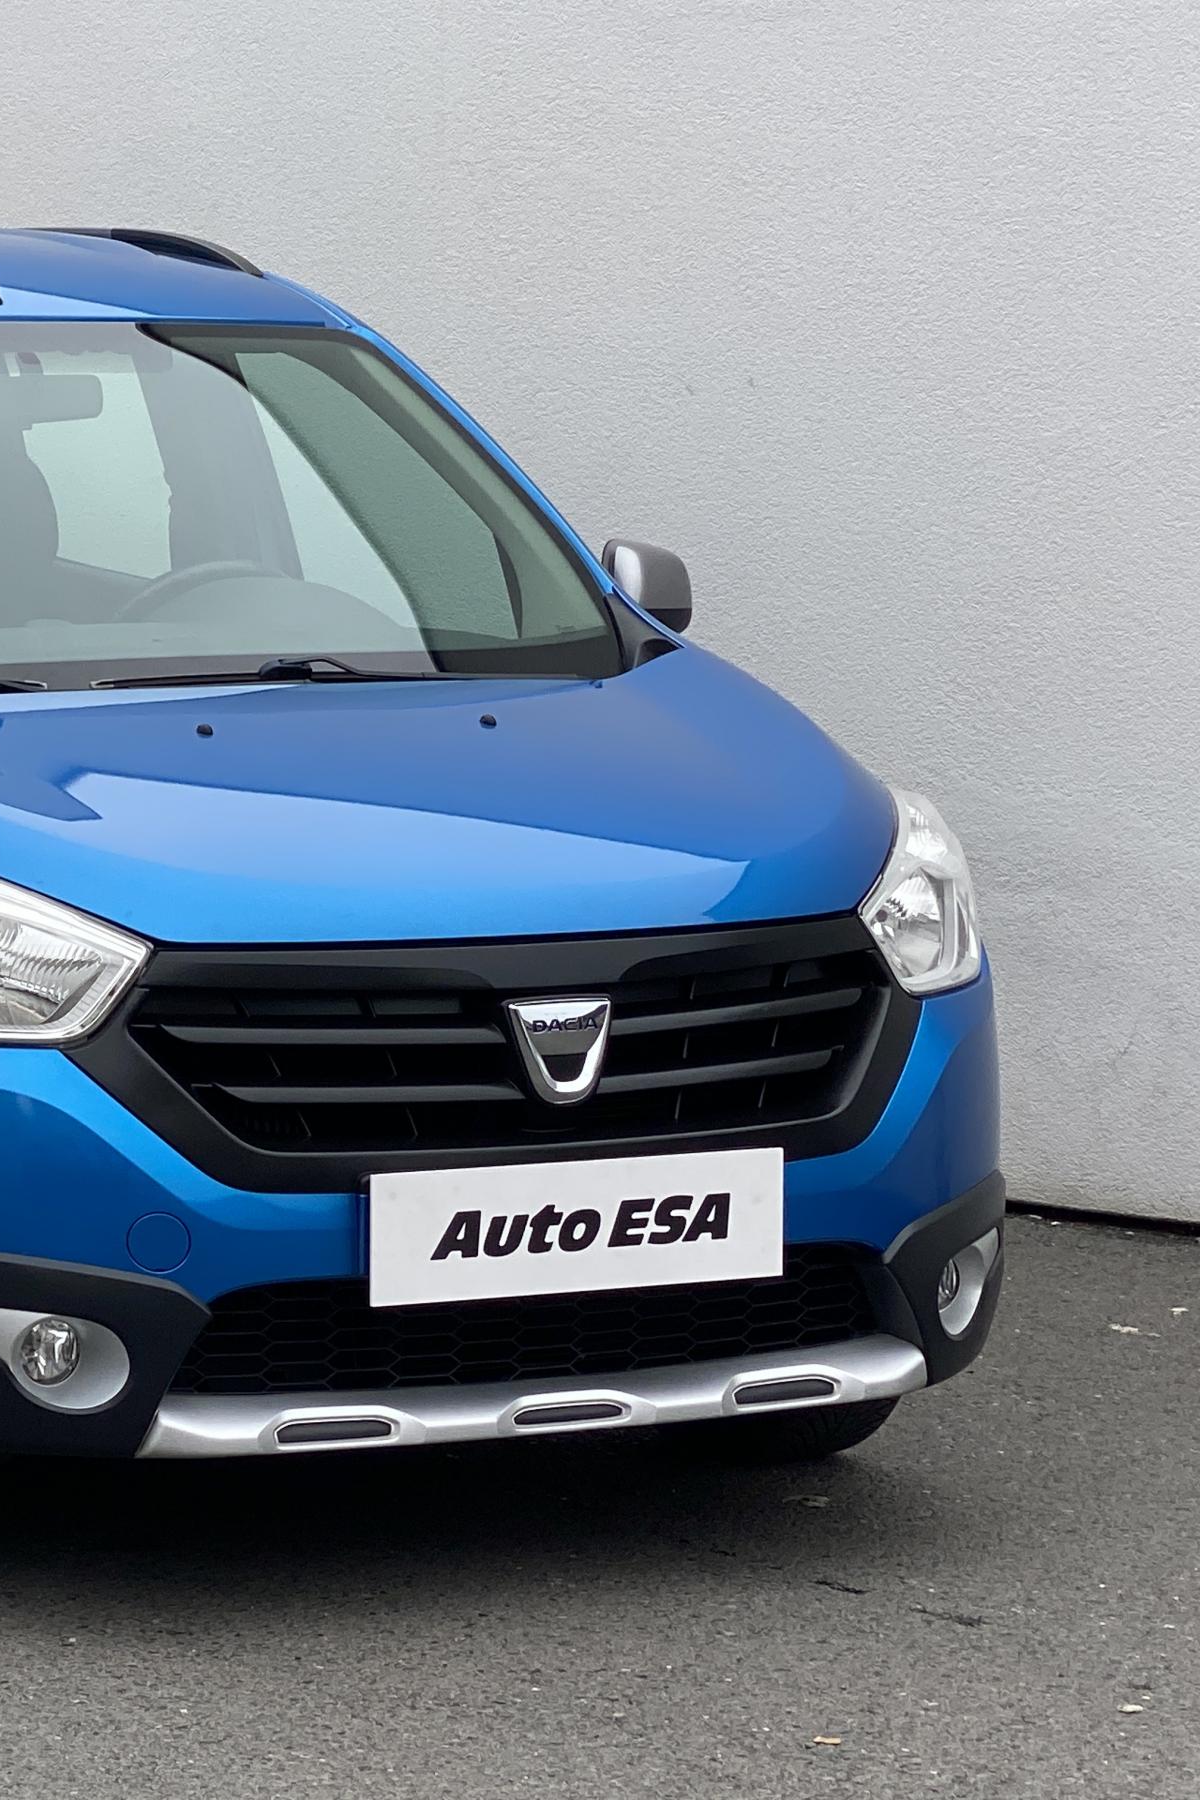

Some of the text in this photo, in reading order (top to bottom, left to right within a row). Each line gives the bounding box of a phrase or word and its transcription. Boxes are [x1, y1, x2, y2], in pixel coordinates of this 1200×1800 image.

[532, 1016, 598, 1033] DACIA
[430, 1192, 731, 1260] Auto ESA
